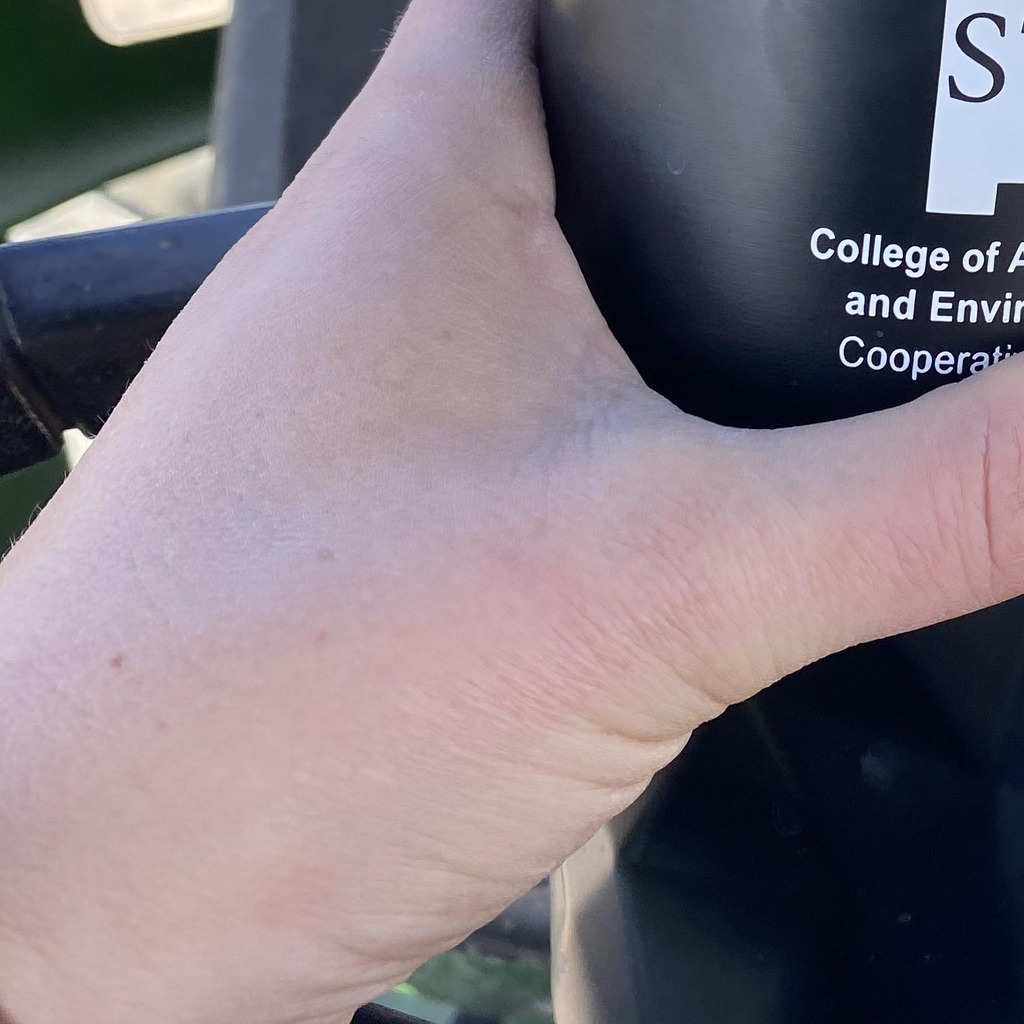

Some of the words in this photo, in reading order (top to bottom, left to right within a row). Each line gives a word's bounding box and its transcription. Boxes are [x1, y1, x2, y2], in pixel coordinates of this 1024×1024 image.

[810, 227, 950, 279] College
[962, 241, 1001, 274] of
[846, 289, 917, 322] and
